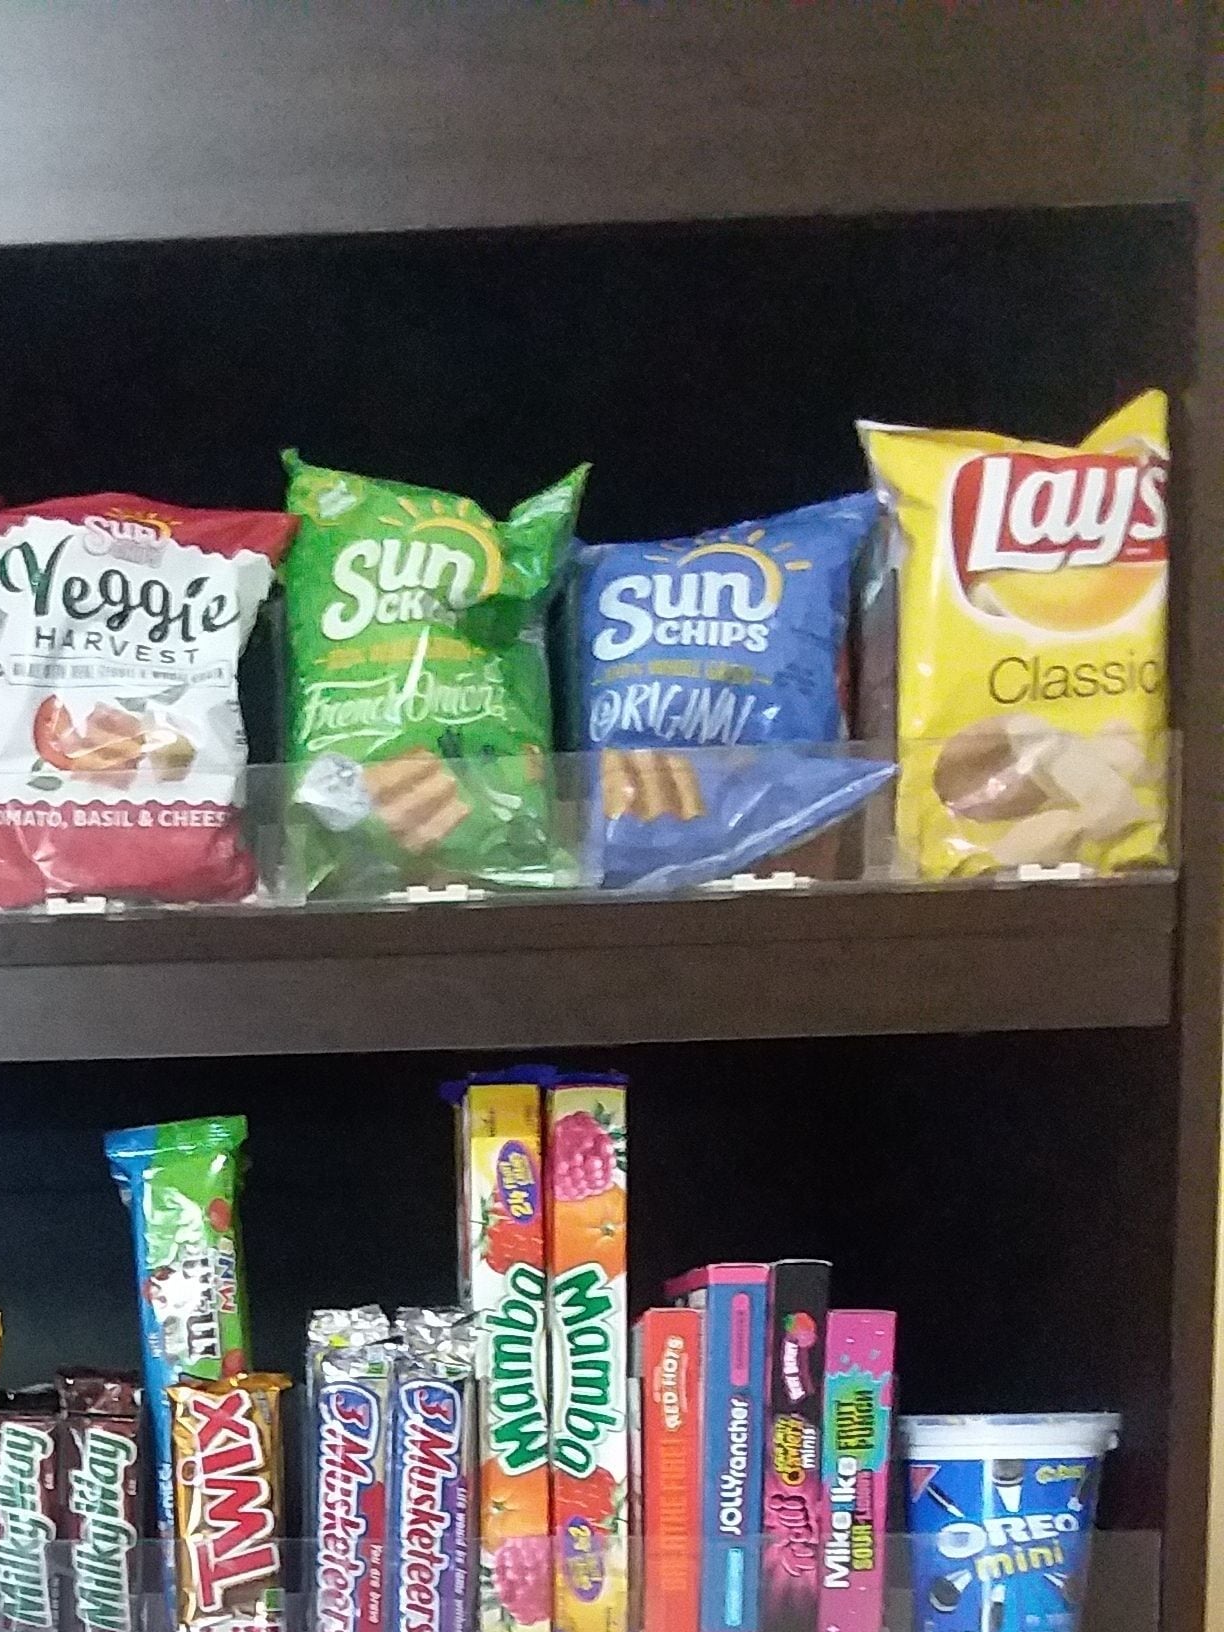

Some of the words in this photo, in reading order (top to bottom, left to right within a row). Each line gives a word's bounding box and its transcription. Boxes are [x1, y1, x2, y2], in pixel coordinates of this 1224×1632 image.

[0, 534, 241, 643] Veggie
[321, 539, 477, 641] Sun
[591, 572, 779, 661] Sun
[655, 620, 770, 653] CHIPS
[35, 626, 200, 665] HARVEST
[989, 654, 1163, 704] Classic
[74, 809, 133, 828] BASIL
[138, 809, 153, 828] &
[484, 1264, 547, 1474] Mambo
[553, 1266, 620, 1475] Mambo
[661, 1337, 684, 1387] HOTS
[334, 1392, 370, 1429] 3
[415, 1390, 451, 1424] 3
[663, 1392, 683, 1429] RED
[837, 1399, 857, 1451] FRUIT
[853, 1390, 874, 1450] PUNCH
[800, 1427, 817, 1469] minis
[937, 1513, 1080, 1559] OREO
[976, 1538, 1064, 1582] mini
